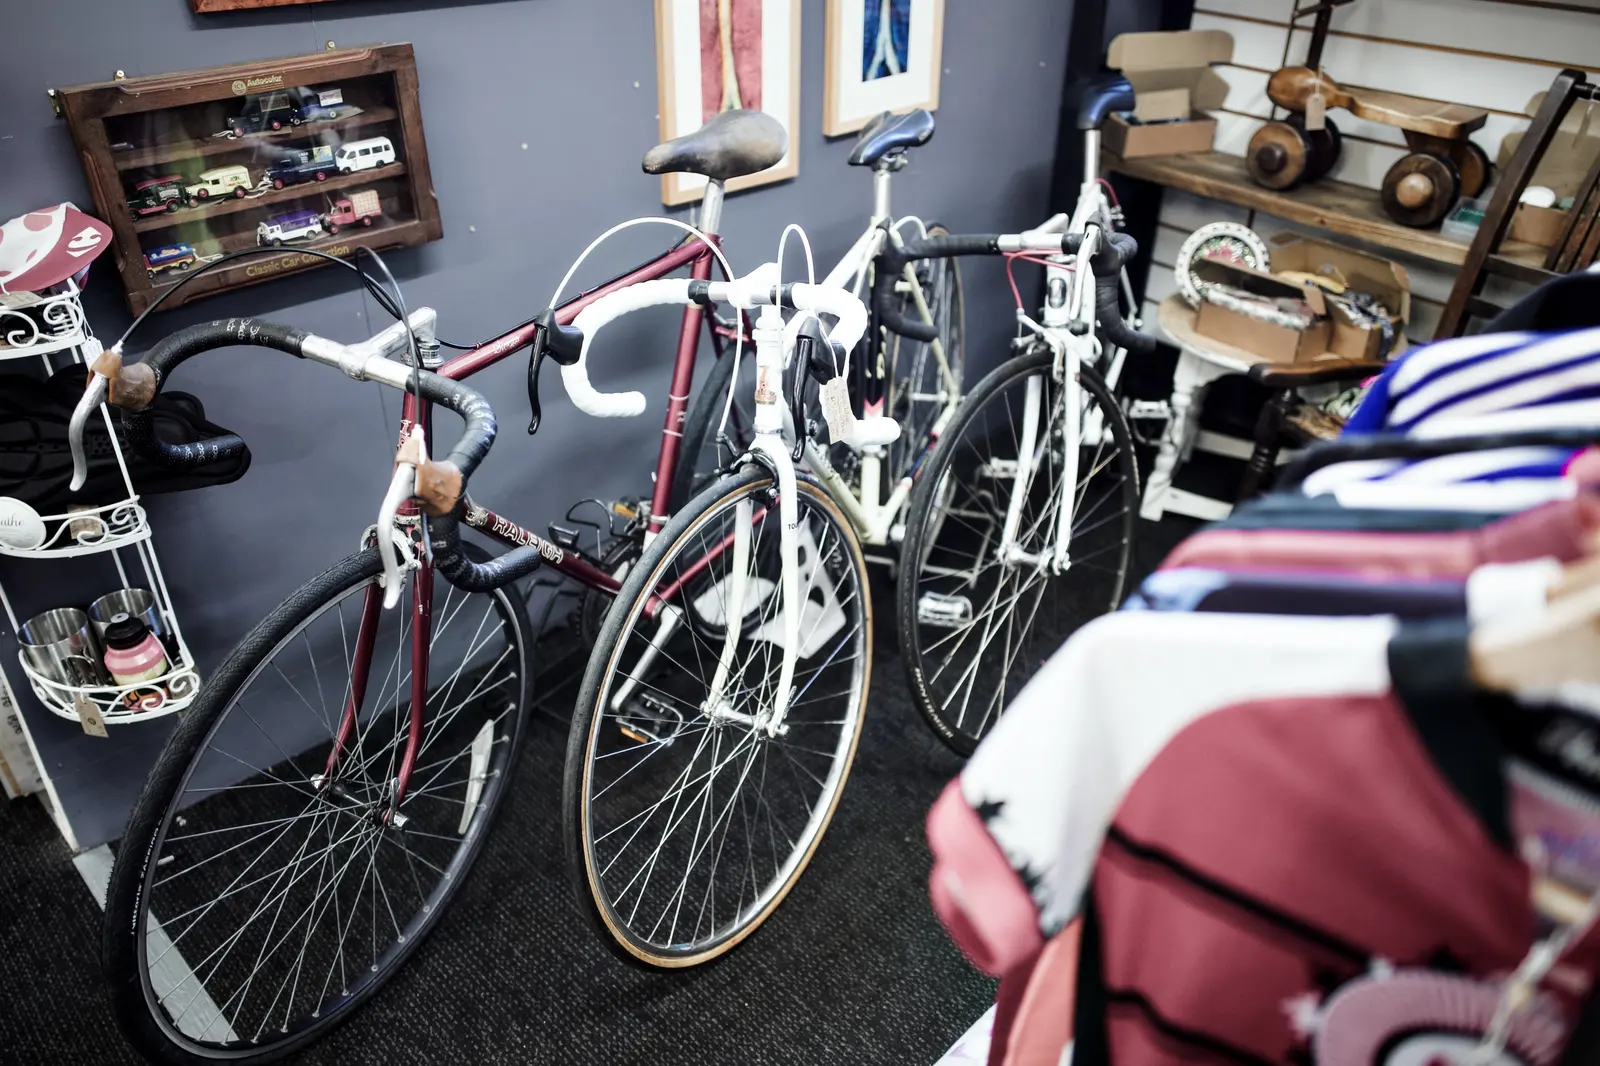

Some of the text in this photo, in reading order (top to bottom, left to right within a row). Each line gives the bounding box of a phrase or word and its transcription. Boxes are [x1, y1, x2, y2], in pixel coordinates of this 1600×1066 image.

[246, 245, 349, 277] Classic Car Colltion
[492, 514, 564, 564] RALEIGH
